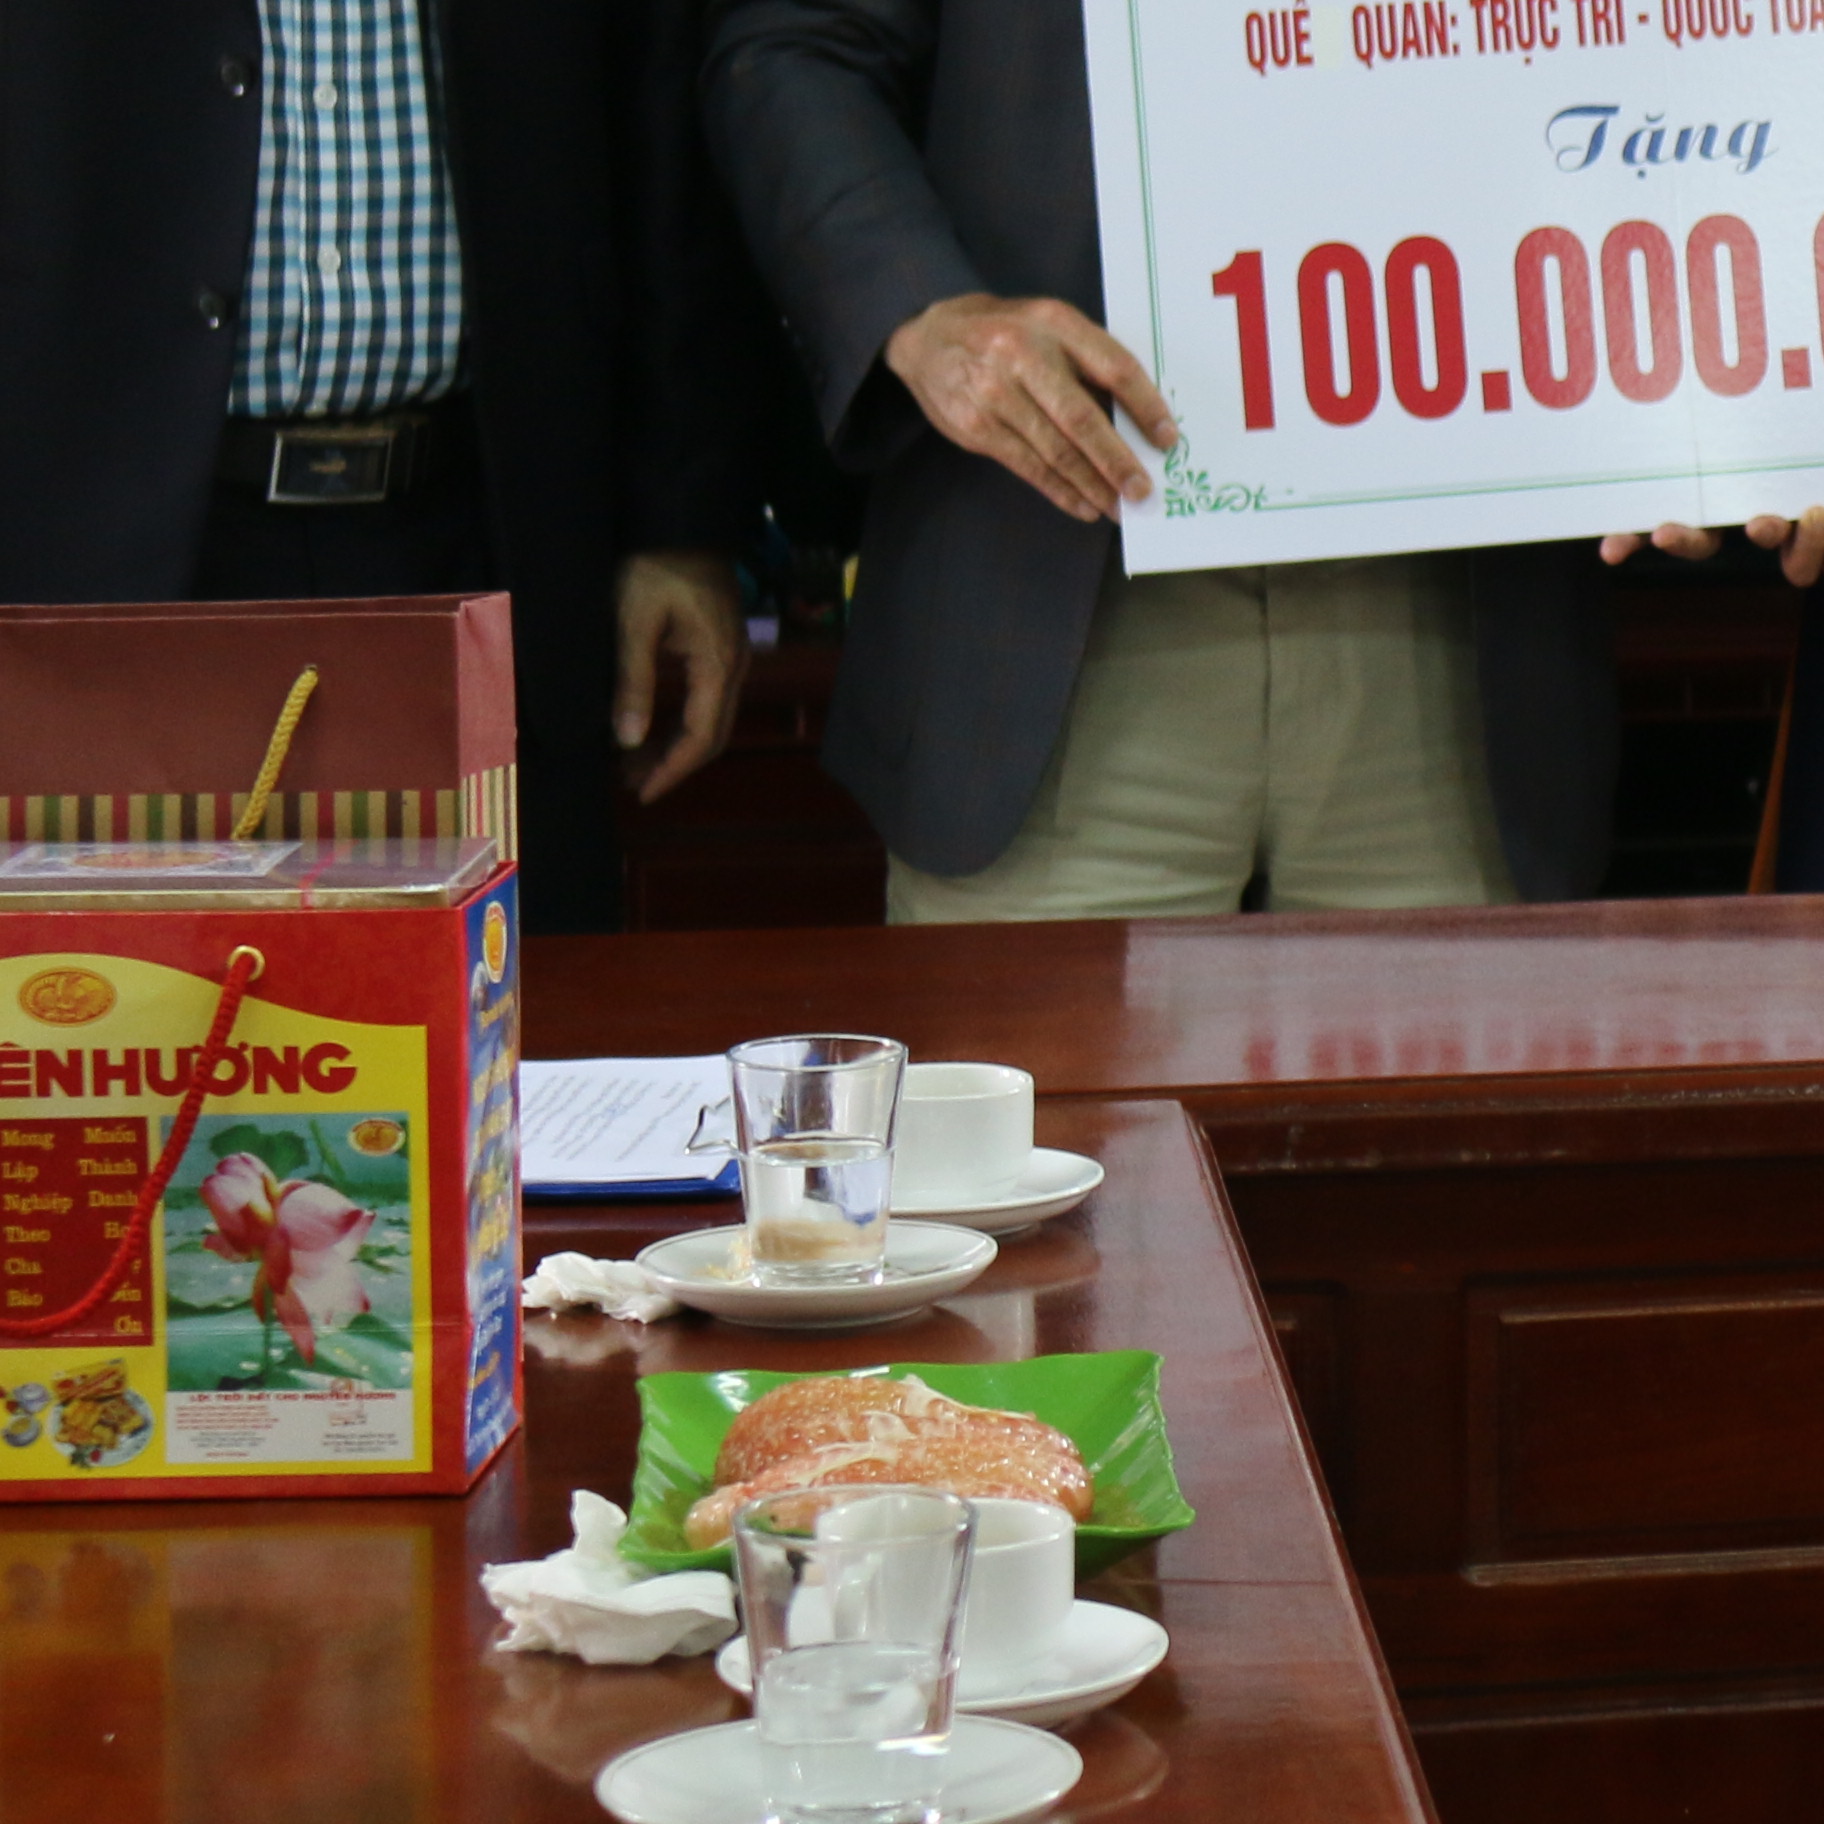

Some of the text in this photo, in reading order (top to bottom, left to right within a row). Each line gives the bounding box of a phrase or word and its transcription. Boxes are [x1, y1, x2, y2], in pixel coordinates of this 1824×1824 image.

[1544, 102, 1779, 180] Tặng
[2, 1129, 56, 1151] Mong
[88, 1189, 139, 1207] Danh
[6, 1225, 51, 1243] Theo
[4, 1257, 43, 1275] Cha
